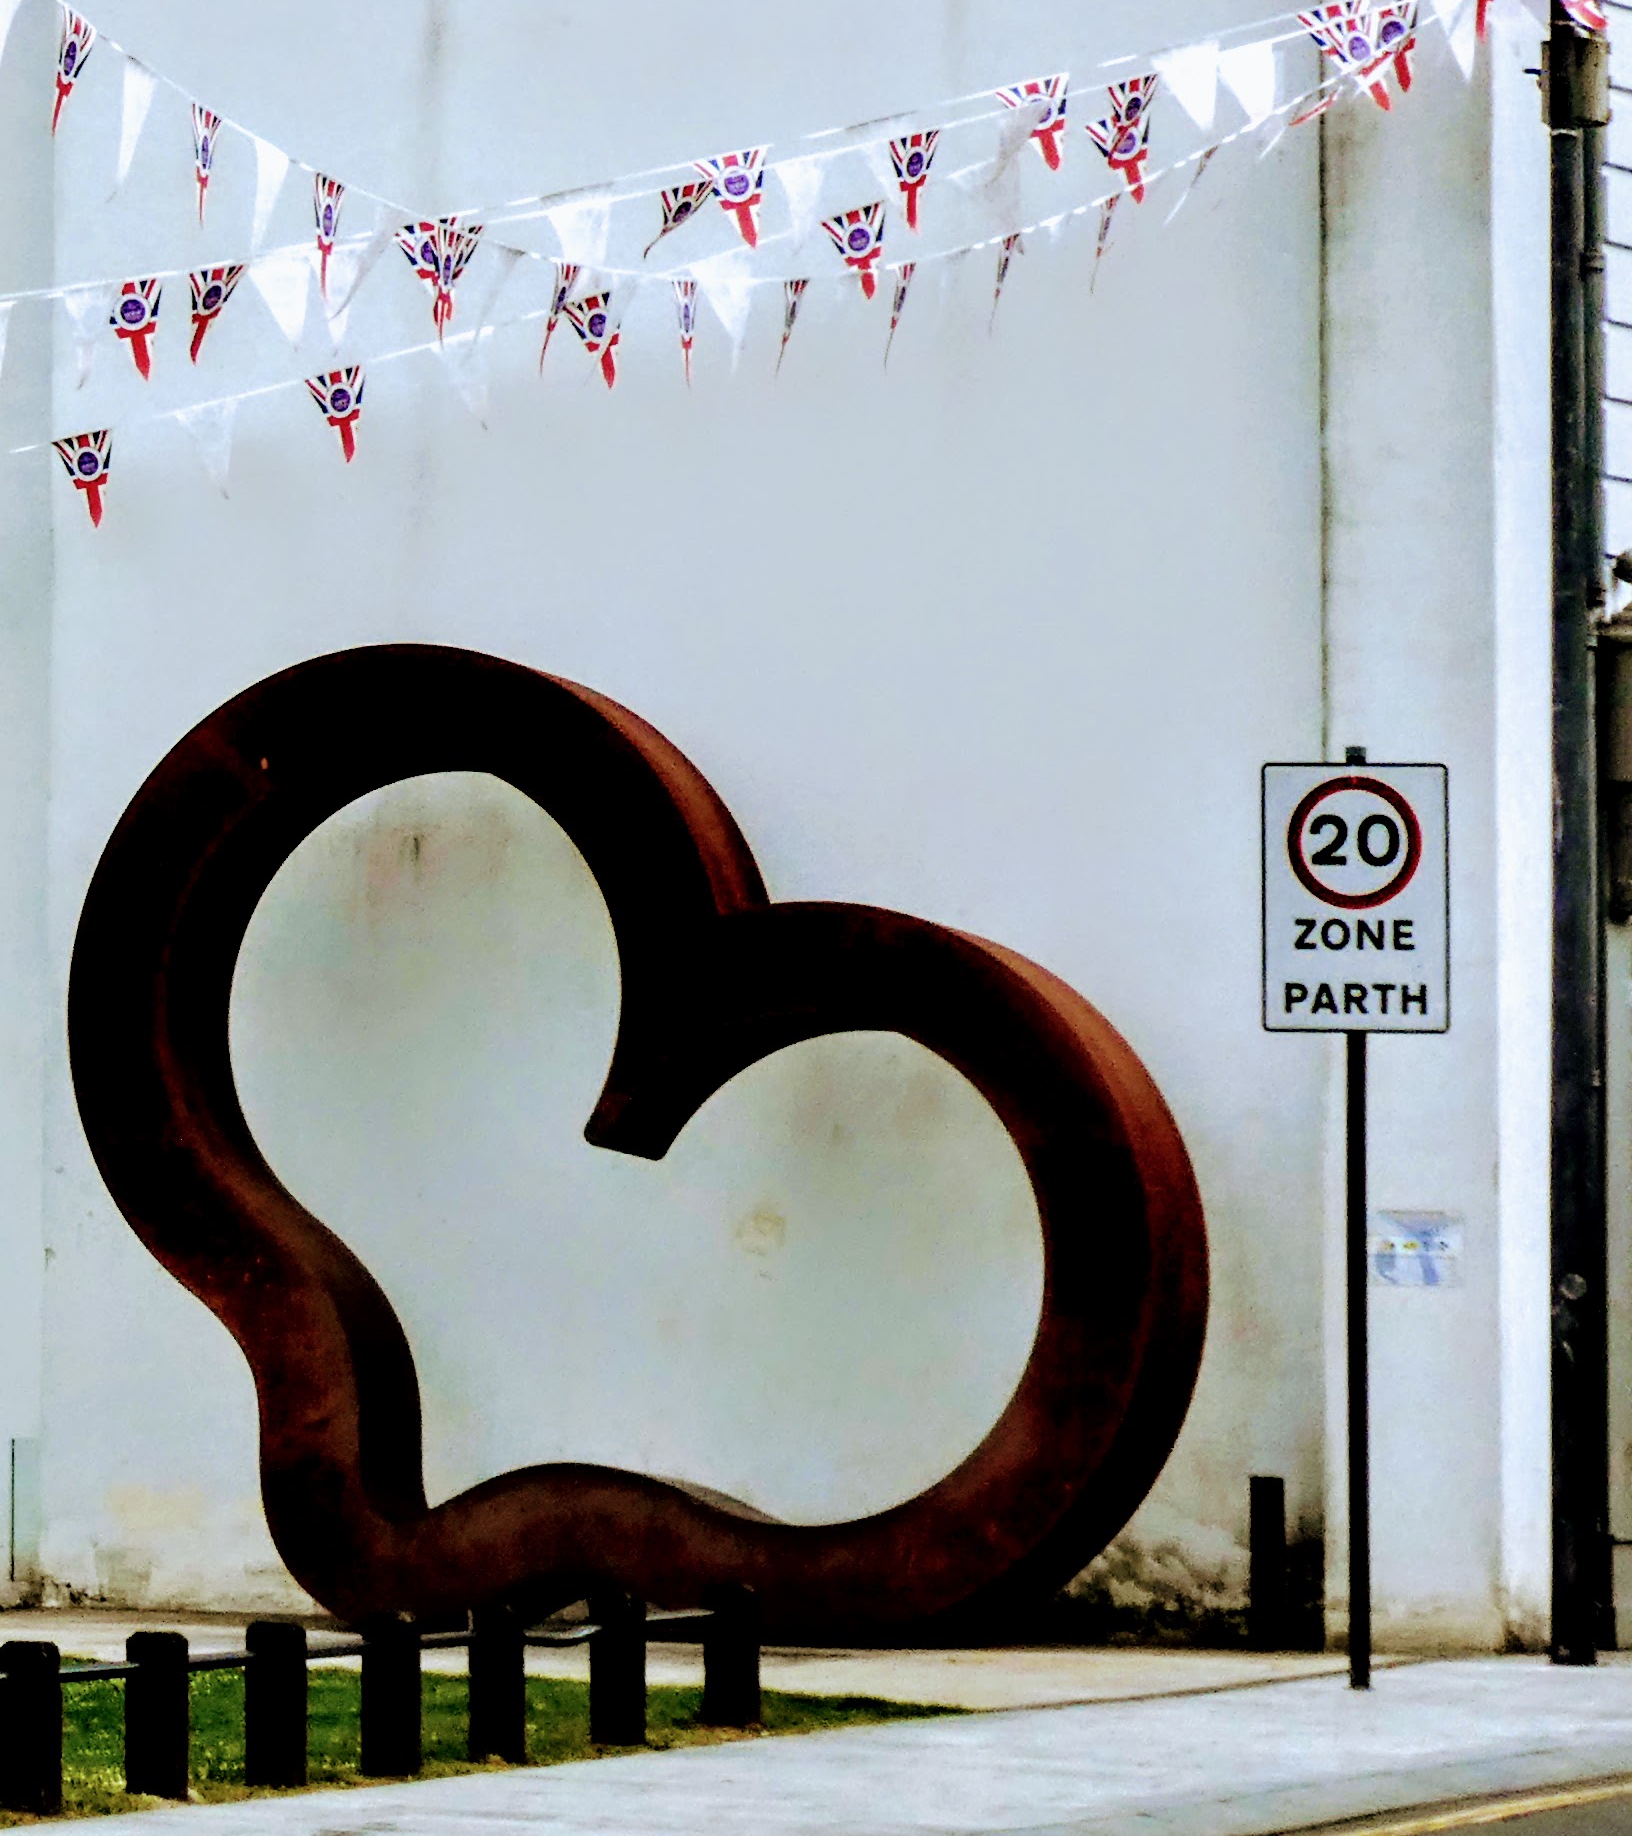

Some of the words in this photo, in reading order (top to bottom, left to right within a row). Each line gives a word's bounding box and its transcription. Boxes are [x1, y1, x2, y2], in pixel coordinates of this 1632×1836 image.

[1309, 813, 1400, 867] 20
[1294, 918, 1415, 951] ZONE
[1284, 982, 1427, 1015] PARTH
